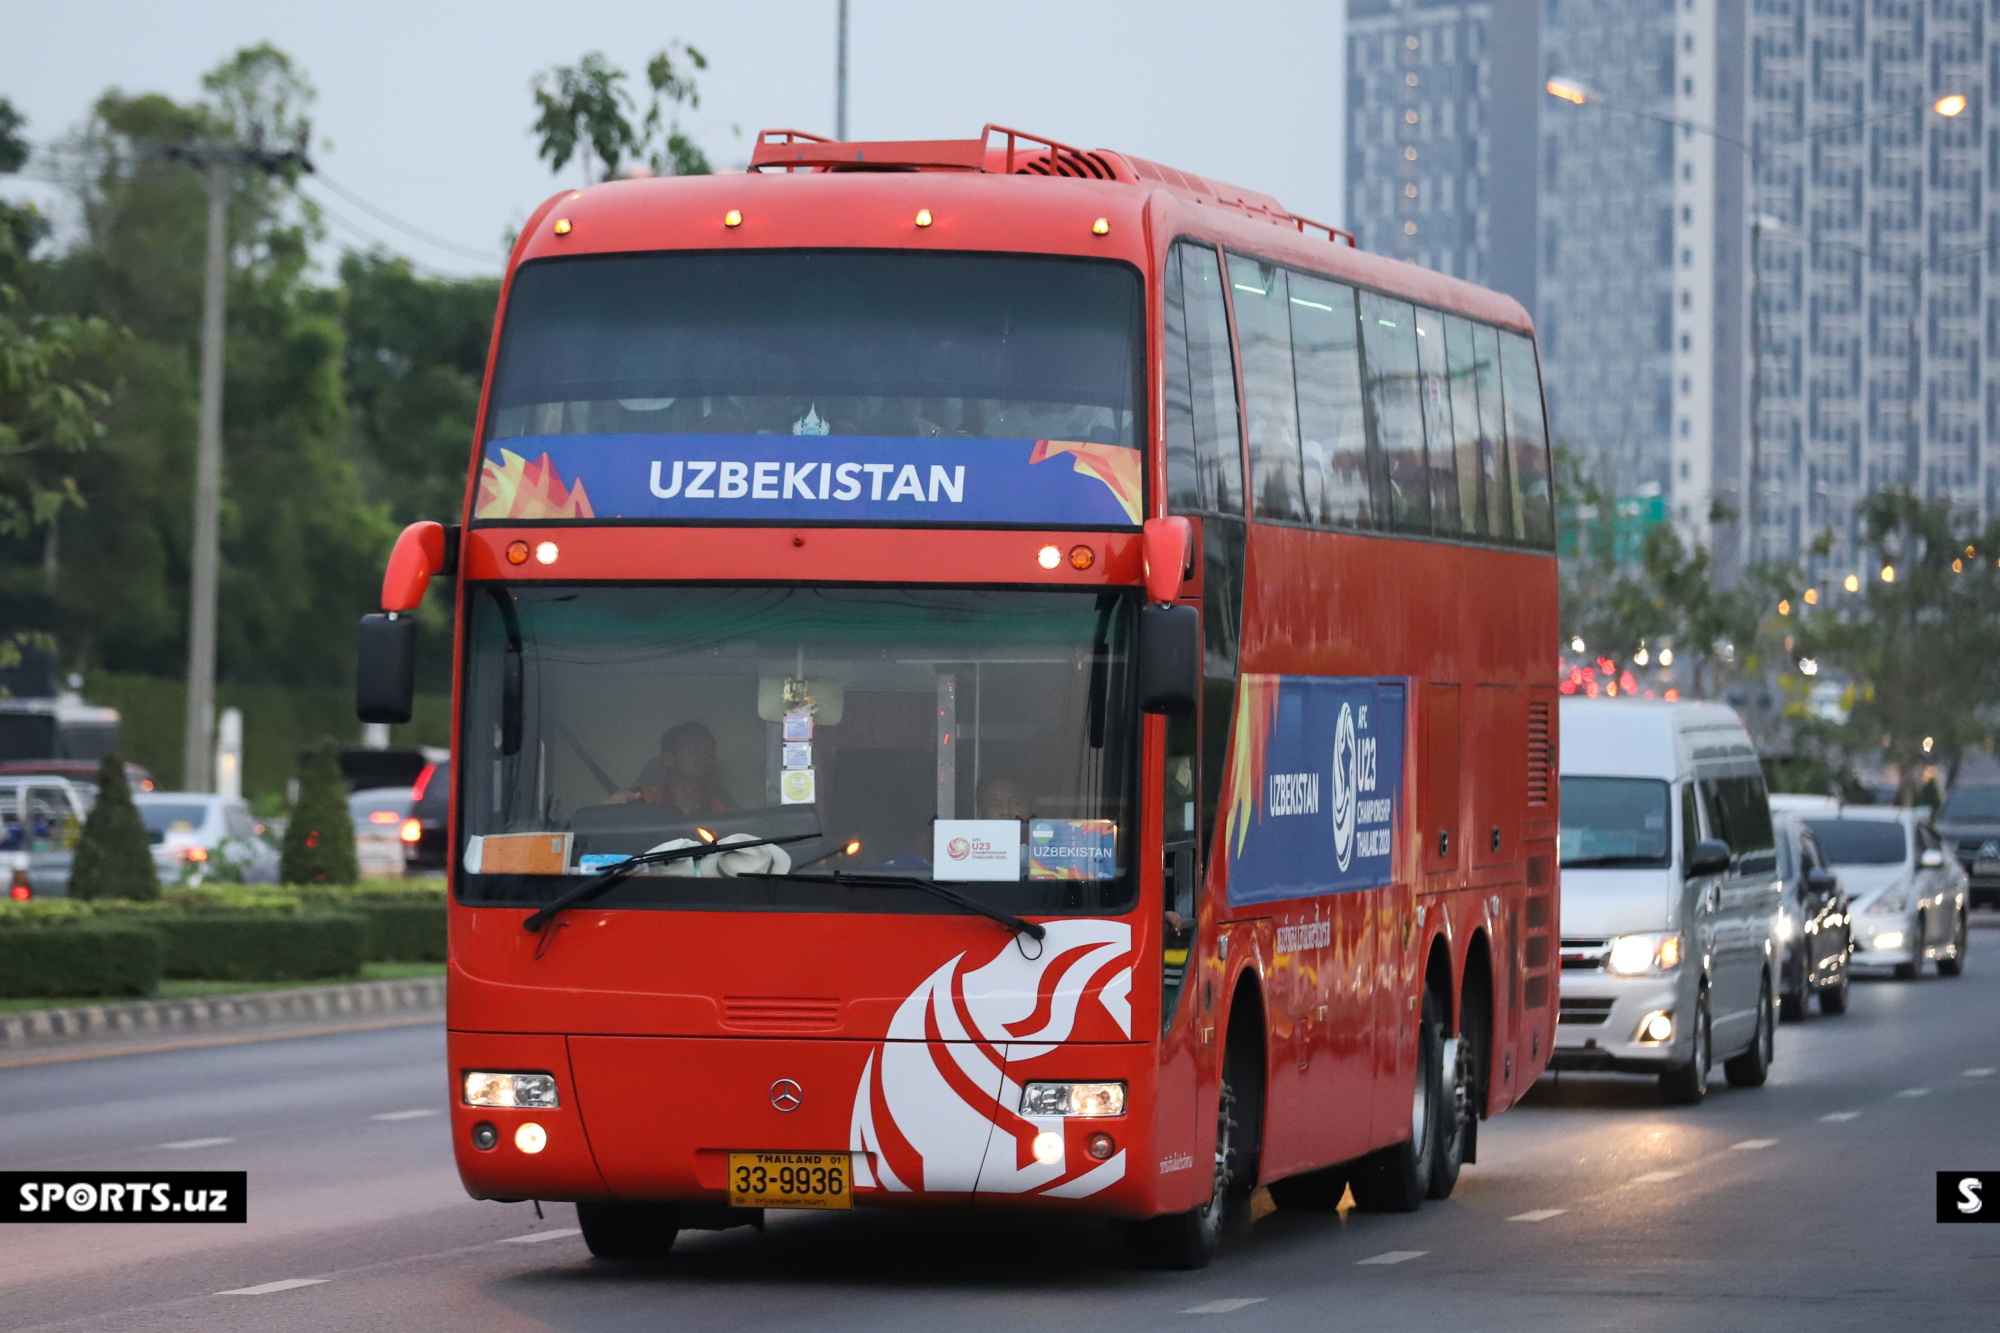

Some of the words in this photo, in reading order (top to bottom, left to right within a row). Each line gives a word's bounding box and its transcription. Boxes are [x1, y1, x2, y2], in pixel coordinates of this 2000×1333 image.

[649, 460, 966, 503] UZBEKISTAN
[1358, 705, 1368, 729] AFC
[1357, 737, 1377, 792] U23
[1269, 772, 1319, 817] UZBEKISTAN
[1357, 798, 1391, 824] CHAMPIONSHIP
[972, 842, 991, 851] U23
[1033, 846, 1112, 858] UZBEKISTAN
[756, 1154, 822, 1164] THAILAND
[830, 1156, 841, 1165] 01
[736, 1165, 843, 1195] 33-9936
